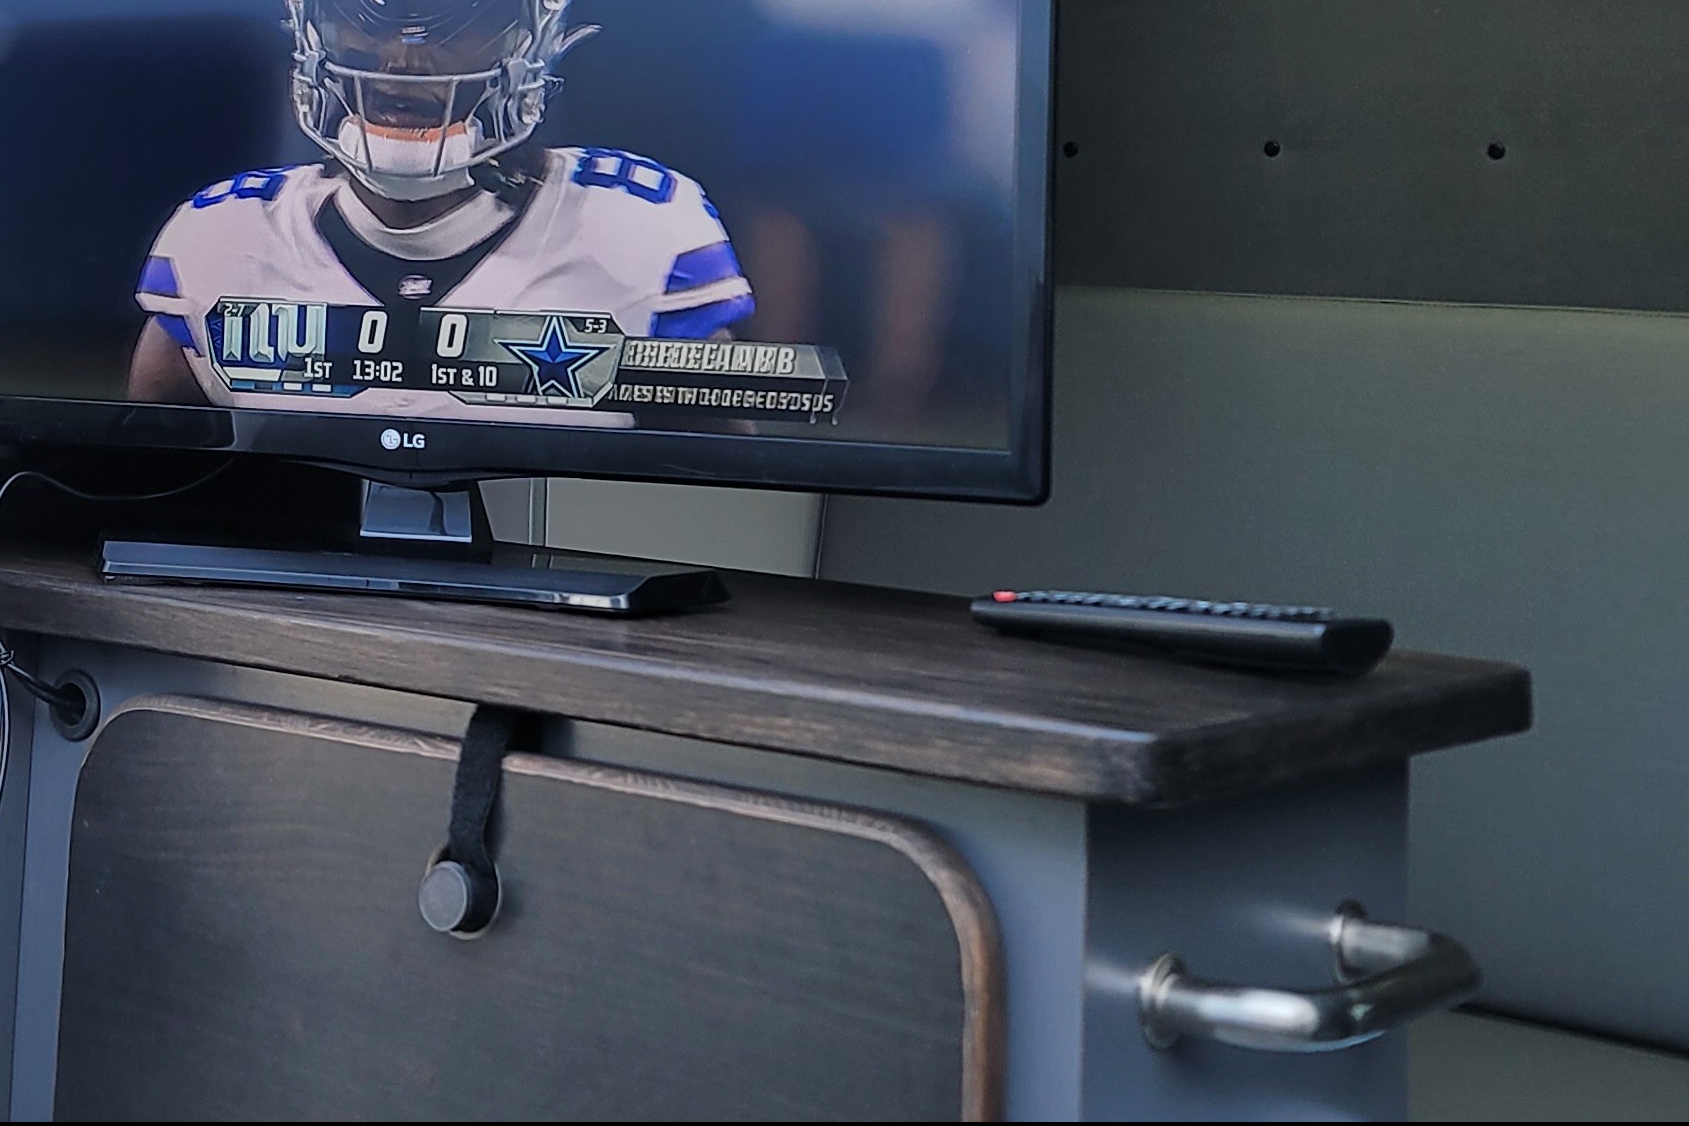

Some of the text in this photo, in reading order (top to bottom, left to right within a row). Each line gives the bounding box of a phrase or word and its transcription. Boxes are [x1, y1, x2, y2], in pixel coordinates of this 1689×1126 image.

[223, 302, 246, 317] 2-7
[357, 310, 388, 354] 0
[436, 313, 468, 358] 0
[583, 319, 608, 334] 5-3
[303, 357, 333, 379] 1ST
[352, 359, 404, 383] 13:02
[430, 363, 498, 388] 1ST & 10
[403, 432, 426, 449] LG
